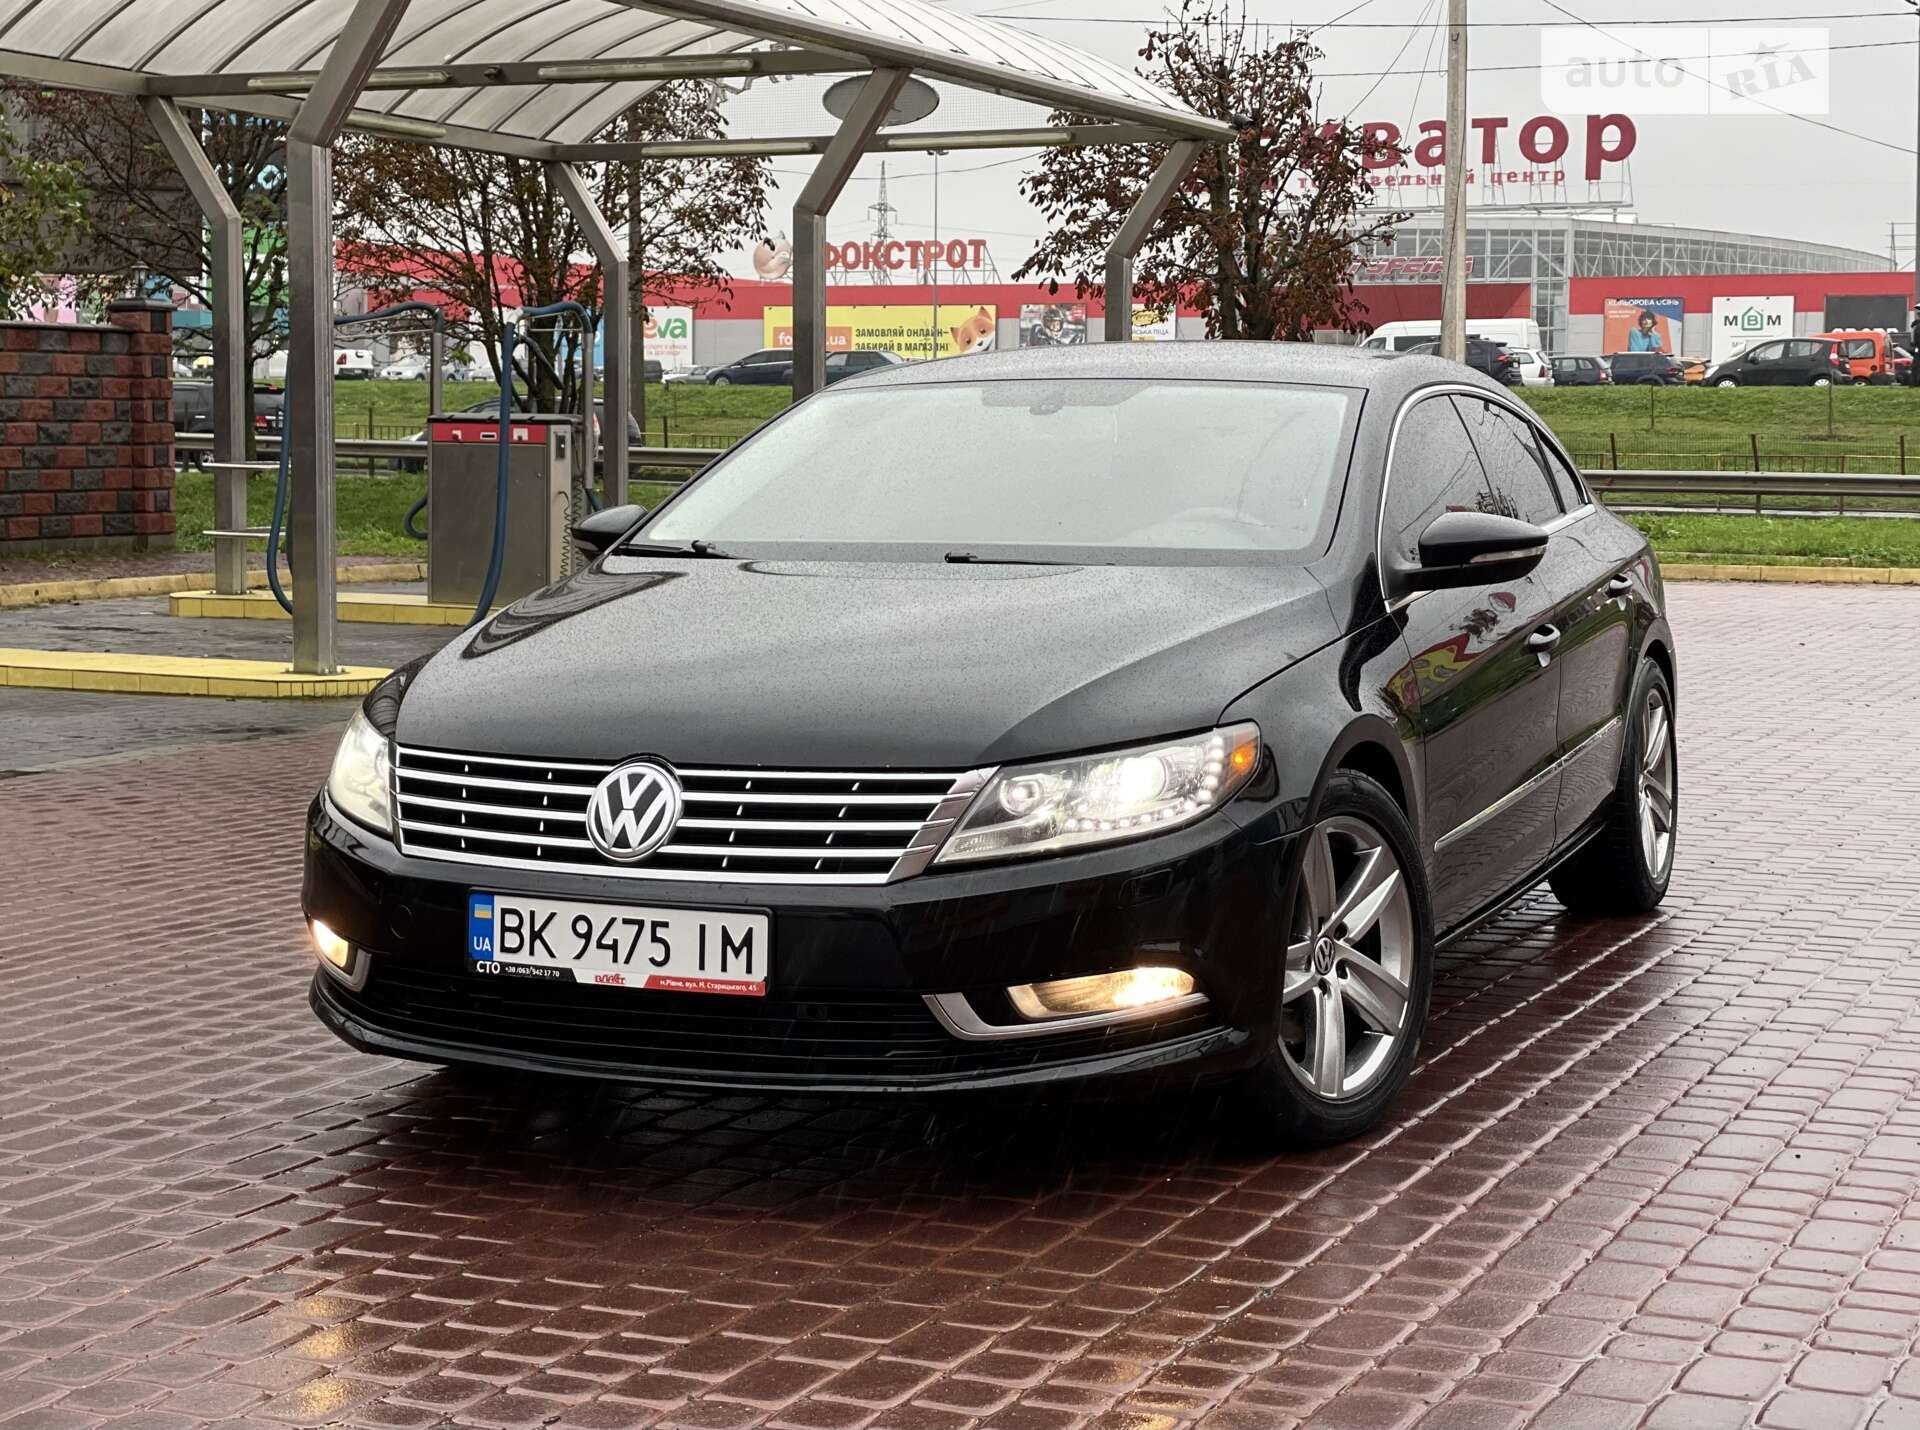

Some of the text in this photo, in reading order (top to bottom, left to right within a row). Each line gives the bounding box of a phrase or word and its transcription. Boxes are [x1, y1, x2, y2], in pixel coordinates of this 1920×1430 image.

[1490, 168, 1566, 187] центр
[825, 238, 987, 271] ФОКСТРОТ
[855, 326, 904, 338] ЗАМОВЛЯЙ
[855, 341, 895, 351] ЗАБИРАЙ
[897, 343, 903, 352] В
[473, 936, 492, 951] UA
[500, 907, 753, 975] BK 9475 IM
[476, 960, 500, 974] СТО
